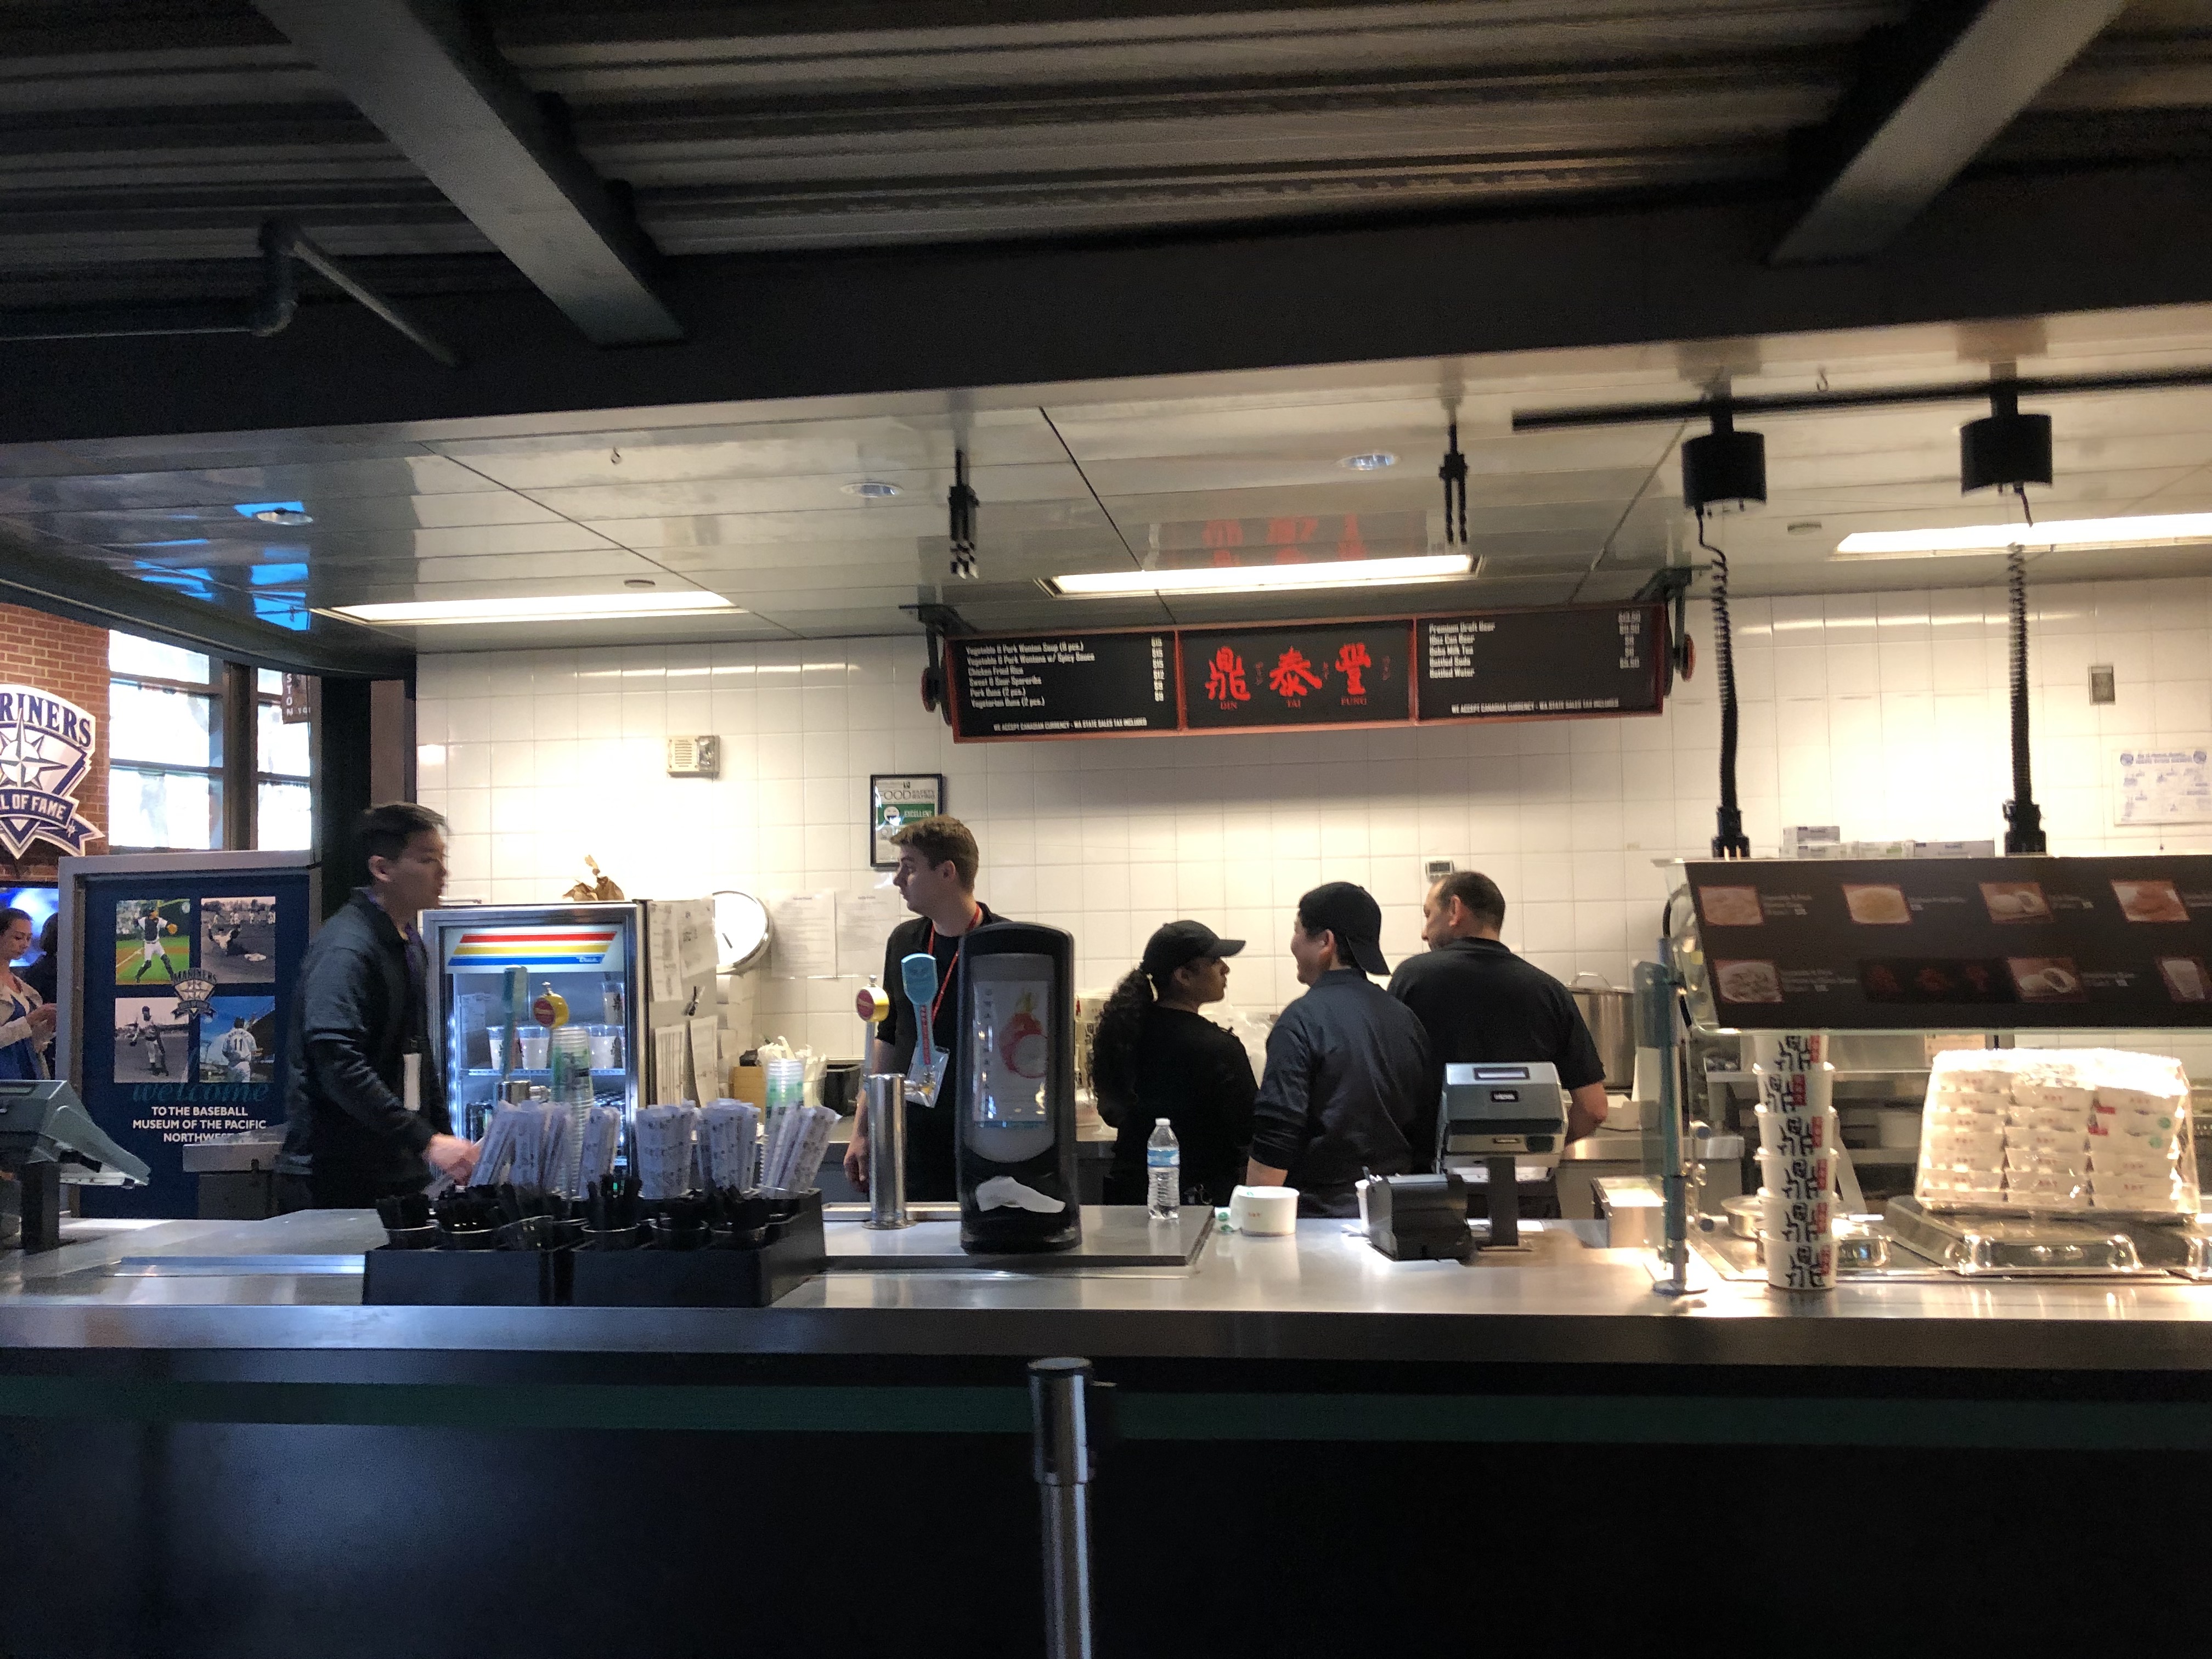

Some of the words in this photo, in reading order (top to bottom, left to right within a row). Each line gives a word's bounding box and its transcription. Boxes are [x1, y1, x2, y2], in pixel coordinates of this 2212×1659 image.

[1429, 623, 1459, 634] Premium
[1479, 620, 1496, 632] Beer
[966, 645, 996, 656] Vegetable
[1003, 644, 1017, 653] Pork
[1019, 642, 1042, 653] Wonton
[1042, 641, 1059, 653] Soup
[1447, 644, 1460, 656] Milk
[1462, 644, 1474, 655] Tea
[967, 655, 997, 667] Vegetable
[1003, 654, 1019, 664] Pork
[1047, 652, 1057, 663] w/
[1057, 651, 1074, 664] Spicy
[1075, 651, 1096, 662] Sauce
[968, 666, 992, 676] Chicken
[992, 665, 1009, 675] Fried
[1009, 664, 1024, 675] Rice
[1430, 667, 1453, 679] Bottled
[1454, 666, 1475, 677] Water
[969, 676, 988, 686] Sweet
[995, 675, 1010, 685] Sour
[970, 687, 985, 697] Pork
[985, 686, 1001, 697] Buns
[1005, 697, 1020, 707] Buns
[993, 723, 1001, 731] WE
[1002, 722, 1019, 731] ACCEPT
[1020, 721, 1044, 730] CANADIAN
[1045, 720, 1069, 729] CURRENCY
[1073, 720, 1082, 729] WA
[1082, 719, 1097, 728] STATE
[1098, 719, 1113, 727] SALES
[1114, 718, 1123, 727] TAX
[1124, 717, 1147, 726] INCLUDED
[12, 794, 29, 810] OF
[31, 798, 67, 820] FAME
[904, 810, 933, 818] EXCELLENT
[133, 1083, 270, 1102] welcome
[151, 1106, 167, 1116] TO
[168, 1106, 190, 1116] THE
[193, 1106, 249, 1116] BASEBALL
[133, 1120, 179, 1130] MUSEUM
[182, 1120, 198, 1130] OF
[199, 1120, 222, 1130] THE
[224, 1119, 267, 1130] PACIFIC
[163, 1132, 234, 1142] NORTHW
